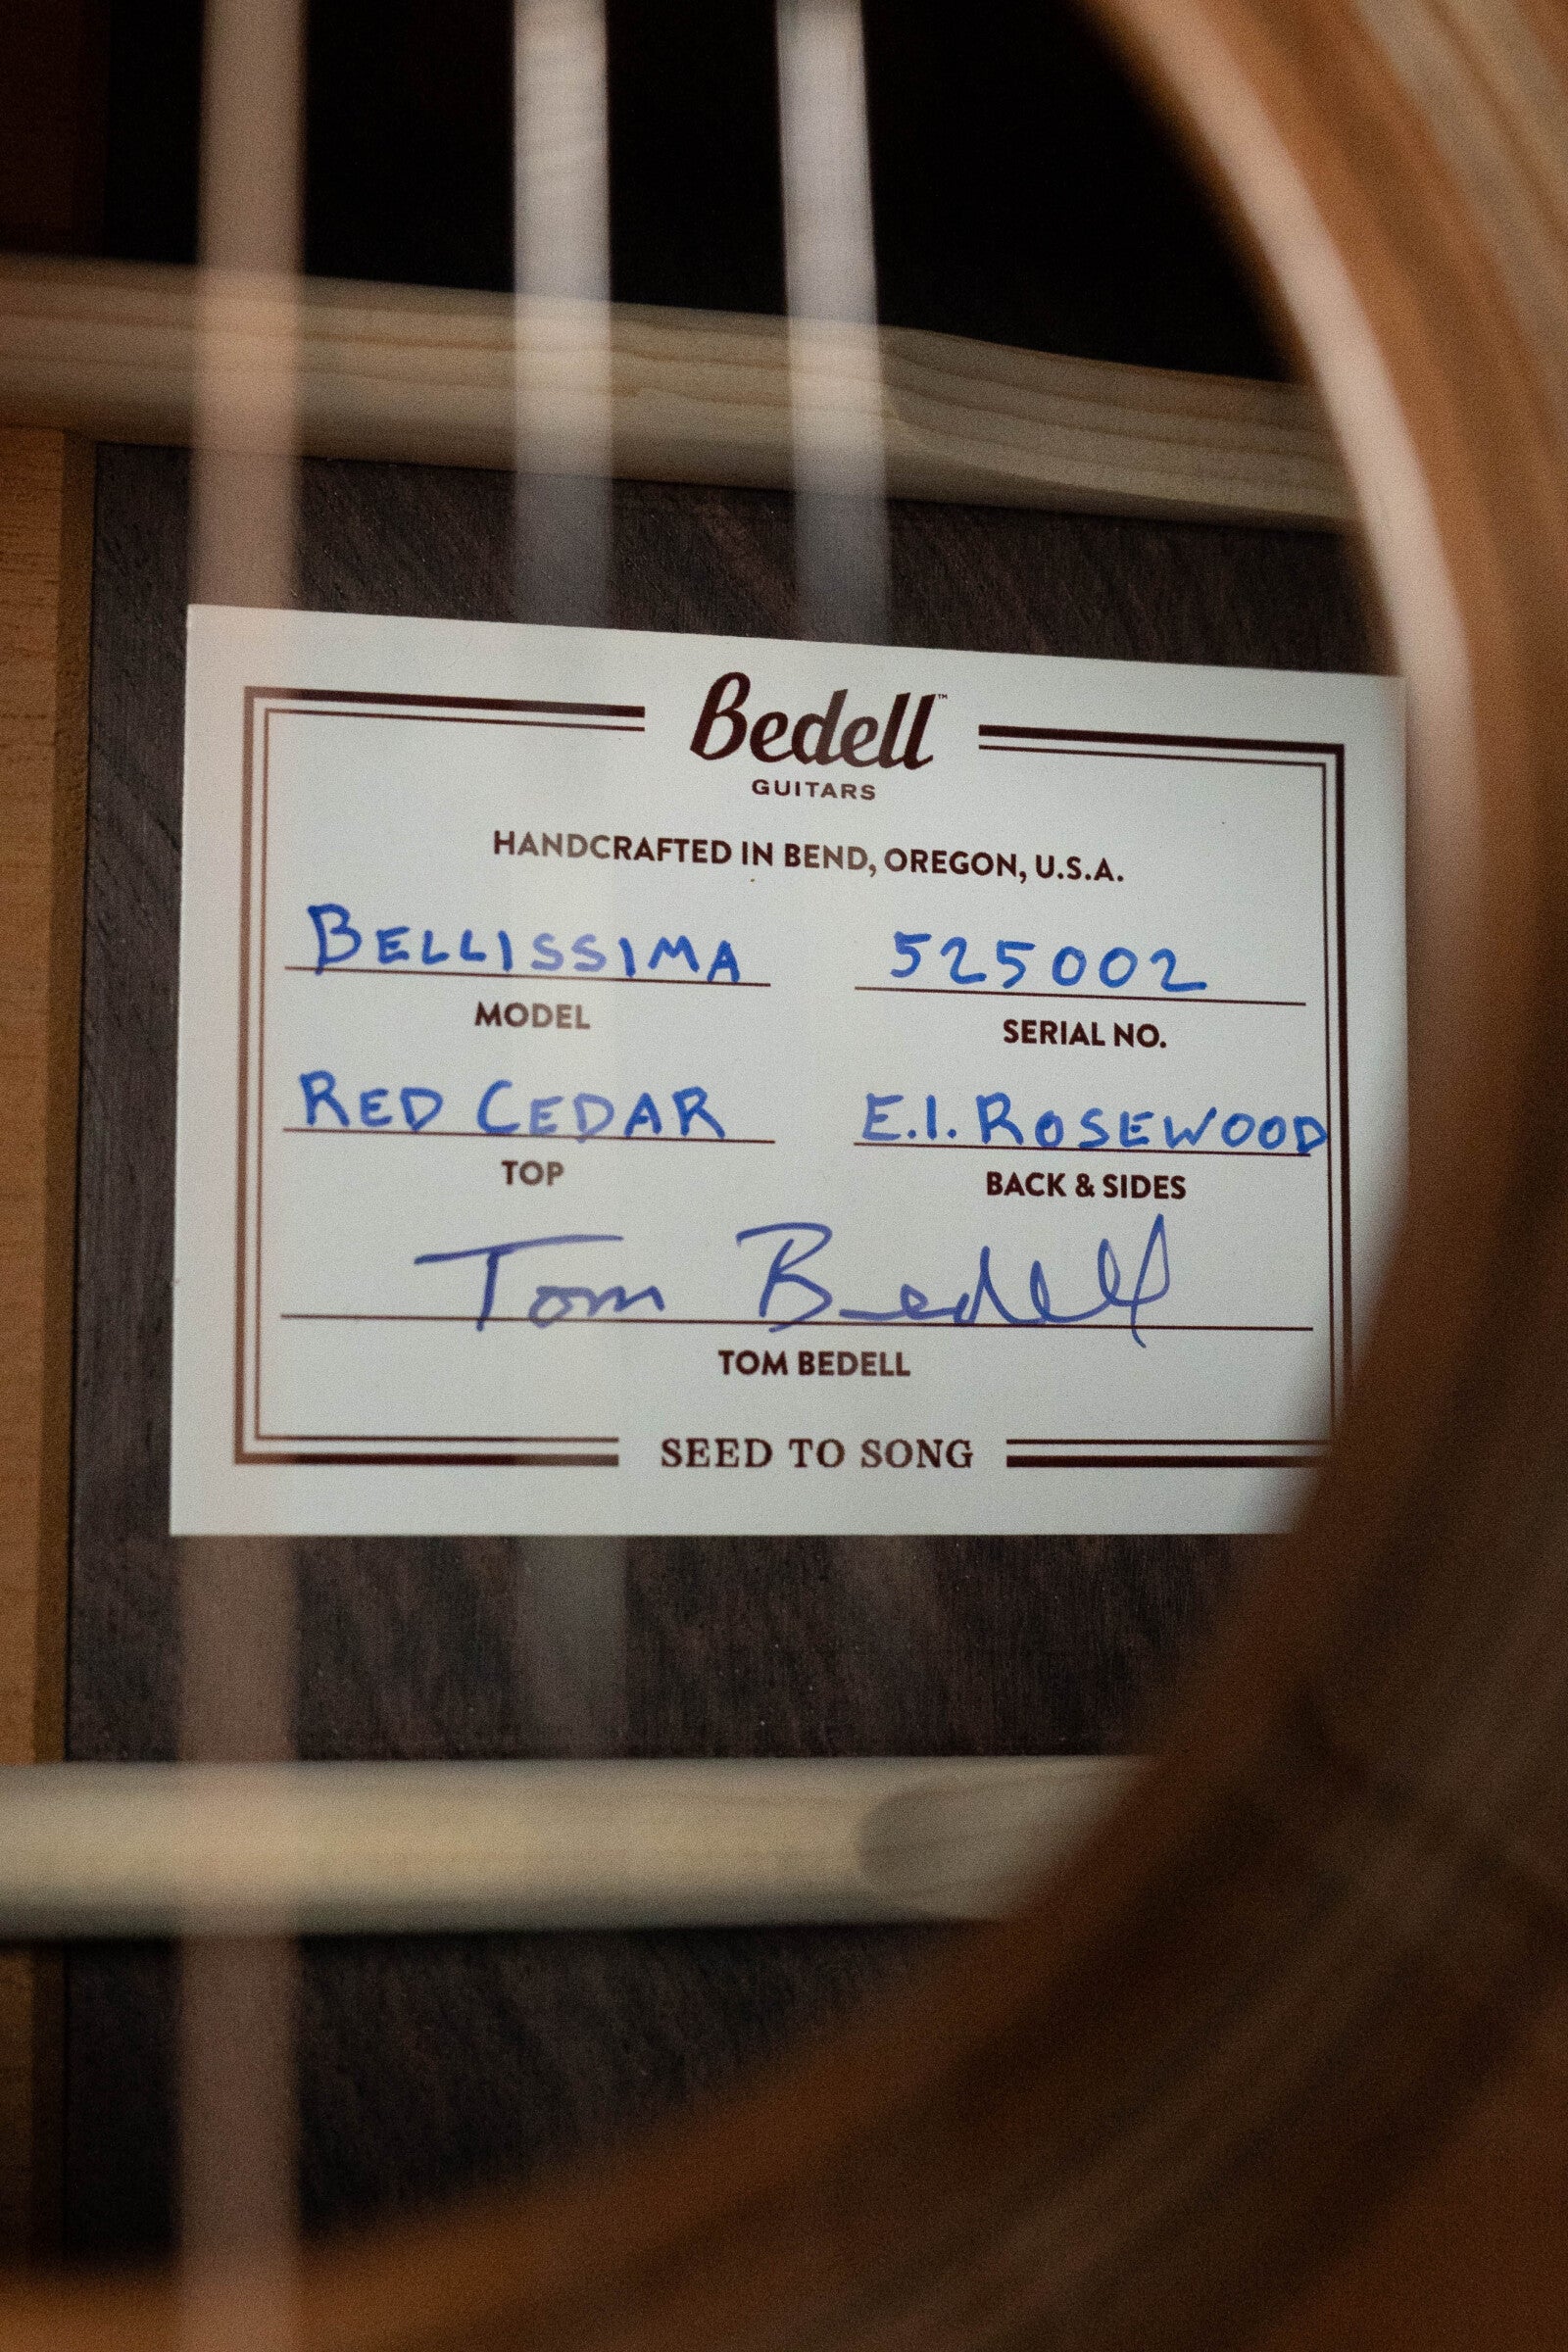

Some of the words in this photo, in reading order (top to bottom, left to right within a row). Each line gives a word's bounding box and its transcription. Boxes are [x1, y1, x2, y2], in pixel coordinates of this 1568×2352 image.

[690, 671, 936, 770] Bedell
[752, 779, 876, 801] GUITARS
[493, 830, 733, 865] HANDCRAFTED
[741, 841, 774, 866] IN
[783, 843, 877, 876] BEND,
[884, 848, 1028, 885] OREGON,
[1035, 855, 1125, 883] U.S.A.
[308, 903, 742, 983] BELLISSIMA
[890, 931, 1207, 993] 525002
[474, 1002, 591, 1030] MODEL
[1003, 1019, 1106, 1047] SERIAL
[1113, 1022, 1167, 1049] NO.
[299, 1069, 444, 1132] RED
[476, 1080, 726, 1144] CEDAR
[976, 1092, 1329, 1154] ROSEWOOD
[502, 1160, 565, 1187] TOP
[986, 1171, 1067, 1198] BACK
[1075, 1173, 1096, 1198] &
[1102, 1173, 1187, 1200] SIDES
[415, 1234, 665, 1332] Tom
[718, 1349, 790, 1377] TOM
[798, 1350, 911, 1378] BEDELL
[661, 1438, 774, 1469] SEED
[788, 1438, 847, 1469] TO
[860, 1438, 975, 1470] SONG
